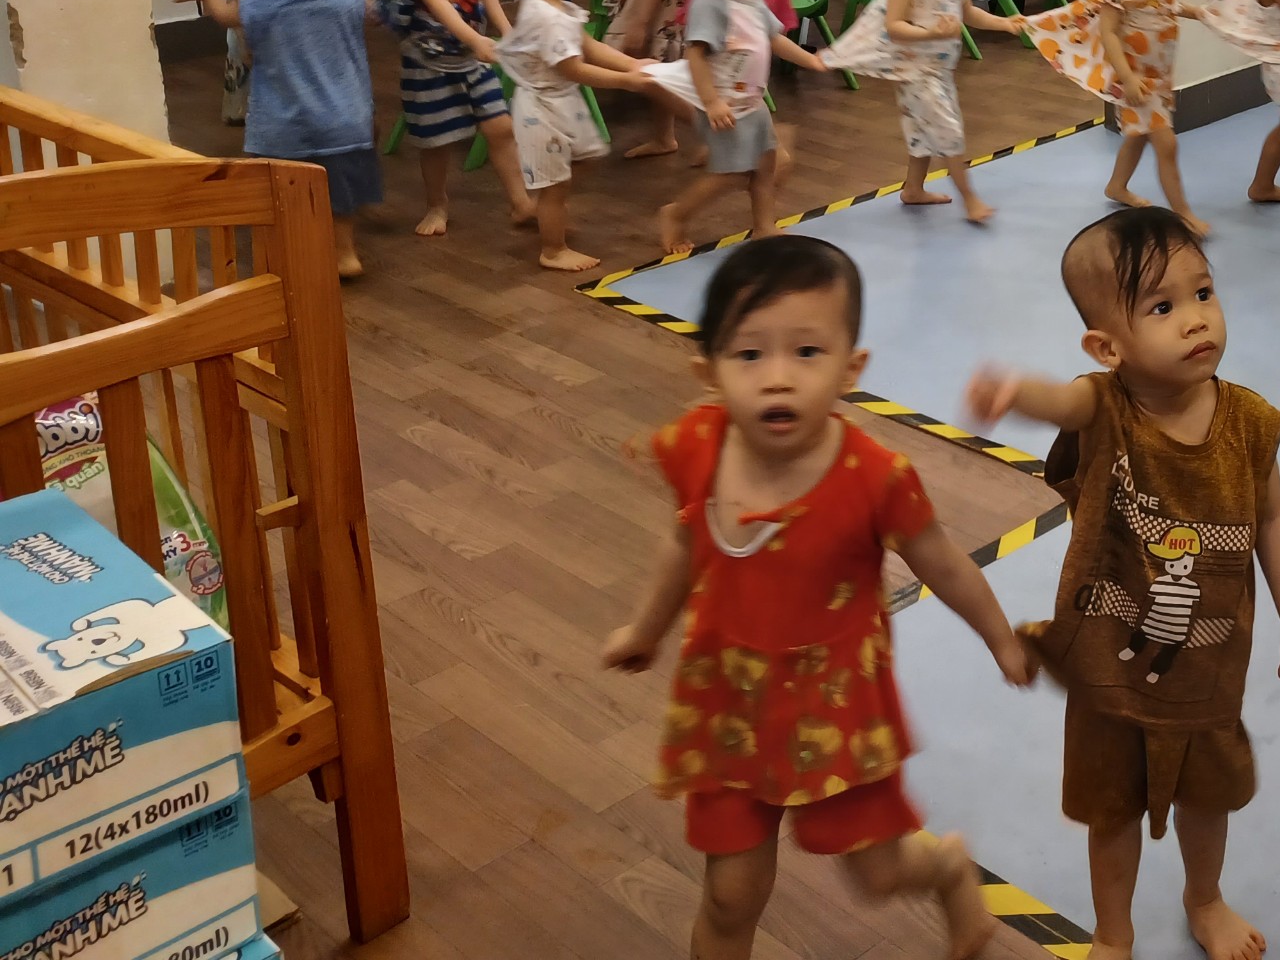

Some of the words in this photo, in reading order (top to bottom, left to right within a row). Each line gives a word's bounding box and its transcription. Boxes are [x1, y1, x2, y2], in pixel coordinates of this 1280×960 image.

[175, 533, 191, 552] 3
[1169, 538, 1196, 551] HOT
[195, 656, 214, 673] 10
[0, 764, 72, 819] ẠNH
[75, 736, 124, 782] MẼ
[6, 760, 46, 790] MỘT
[47, 736, 82, 766] THẾ
[83, 729, 105, 751] HỆ
[65, 781, 209, 859] 12(4x180ml)
[36, 921, 74, 948] MỘT
[75, 892, 108, 924] THẾ
[109, 882, 130, 905] HỆ
[101, 889, 147, 936] MẼ
